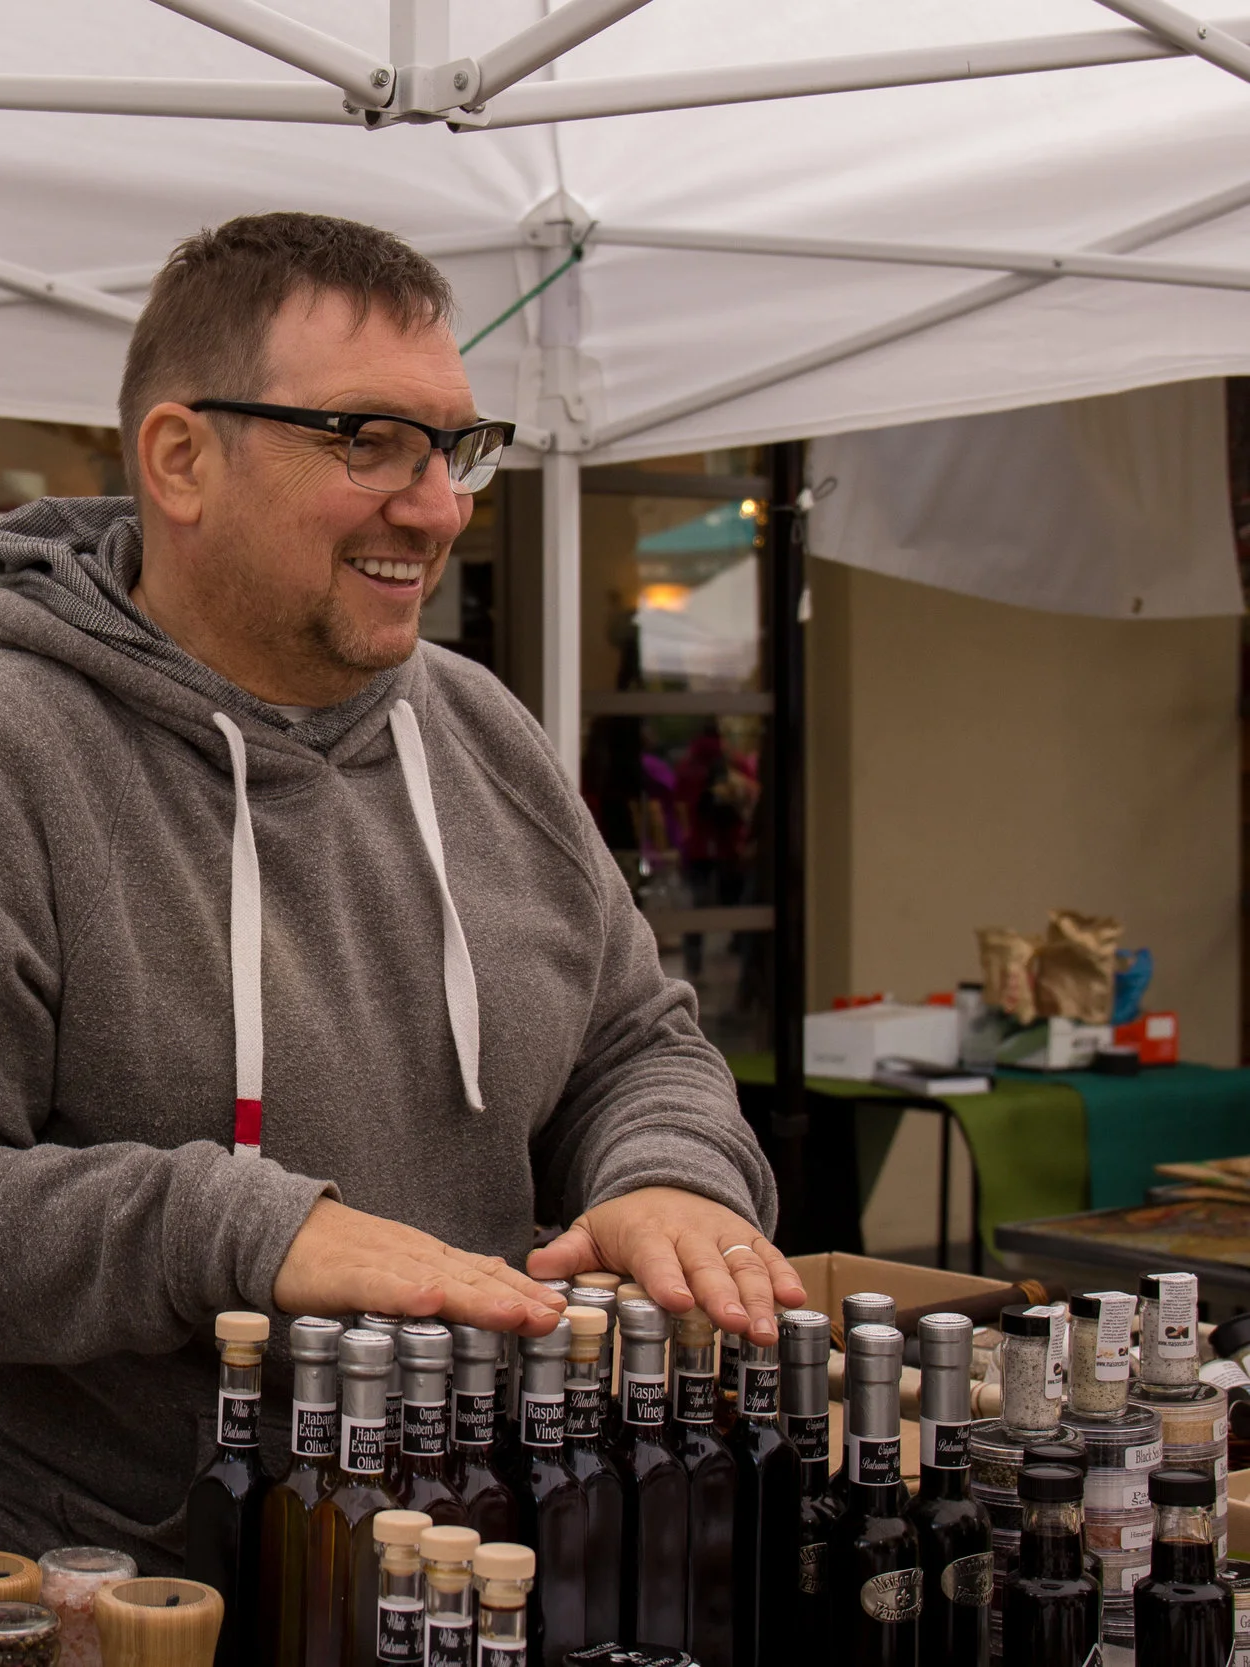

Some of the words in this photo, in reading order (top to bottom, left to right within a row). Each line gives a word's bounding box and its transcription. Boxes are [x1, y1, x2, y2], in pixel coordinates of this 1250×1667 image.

[419, 1407, 442, 1423] Organic
[299, 1423, 324, 1437] Extra
[304, 1440, 329, 1453] Olive
[351, 1440, 376, 1453] Extra
[357, 1456, 381, 1470] Olive
[1135, 1447, 1152, 1464] Black
[871, 1574, 910, 1594] Maison
[386, 1611, 407, 1631] White
[438, 1628, 460, 1648] White
